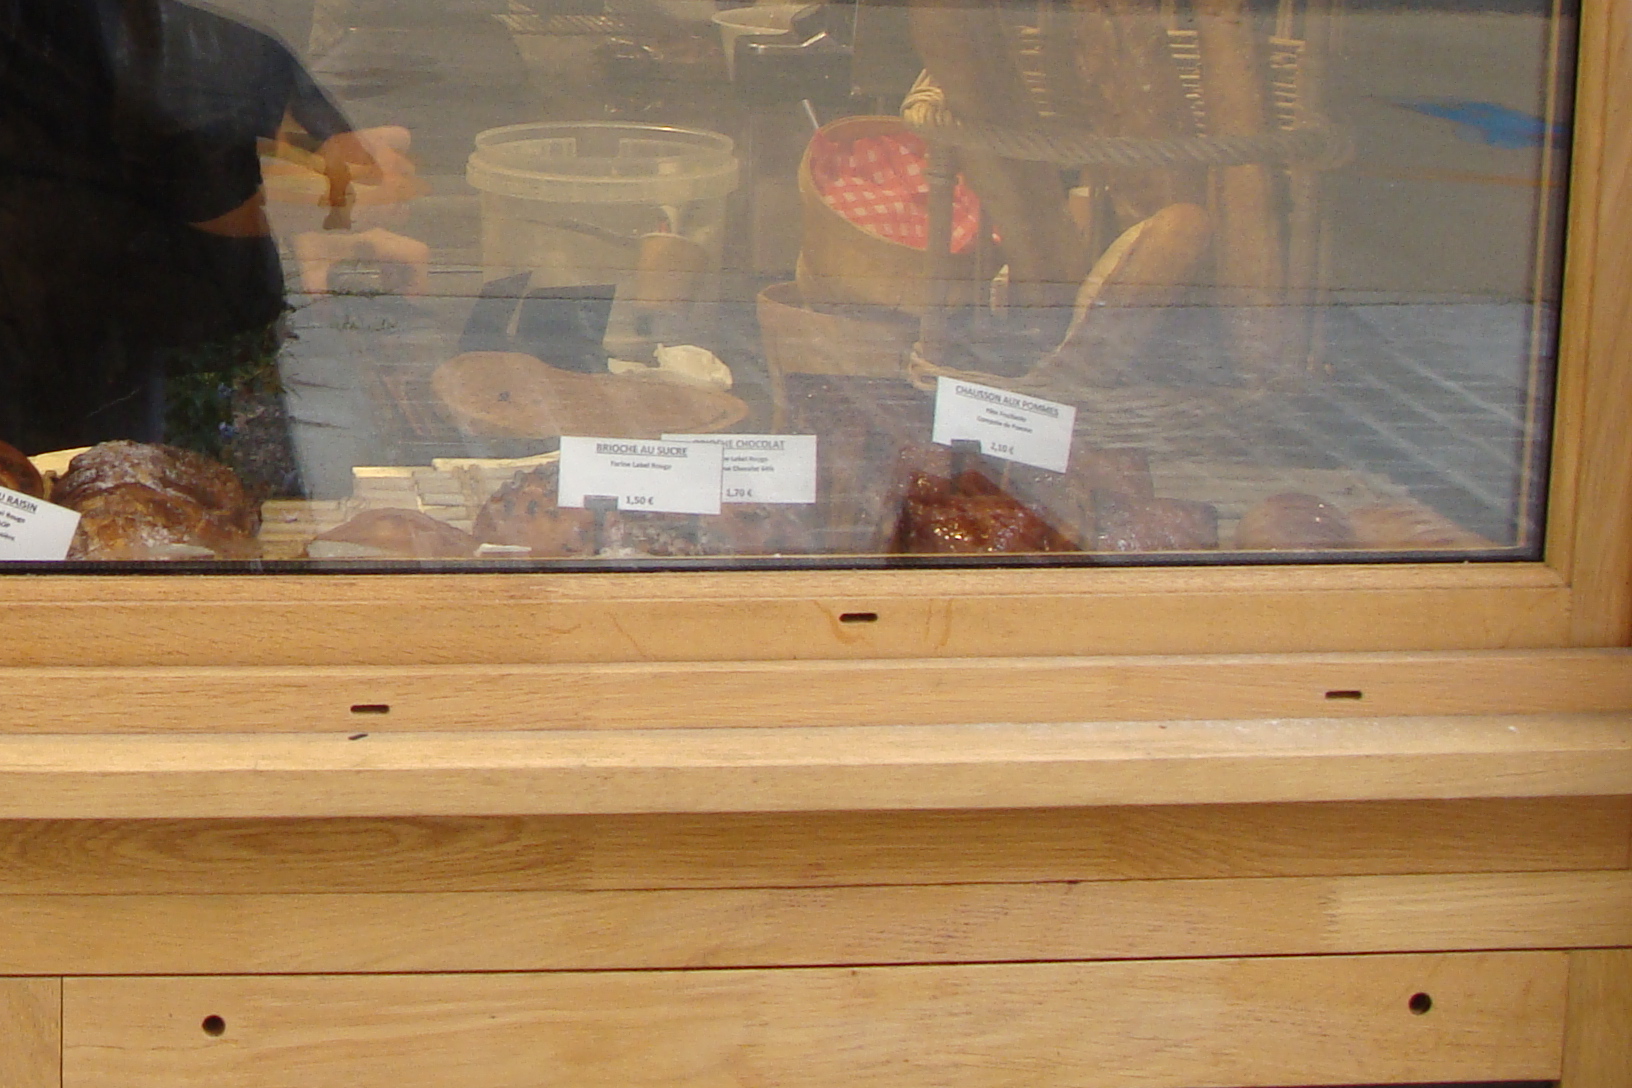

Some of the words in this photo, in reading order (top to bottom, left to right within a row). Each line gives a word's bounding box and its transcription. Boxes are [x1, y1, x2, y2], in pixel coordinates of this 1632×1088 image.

[955, 385, 1001, 403] CHAUSSON
[1003, 396, 1020, 407] AUX
[1022, 400, 1059, 417] POMMES
[596, 443, 638, 454] BRIOCHE
[640, 445, 655, 455] AU
[657, 446, 688, 457] SUCRE
[736, 439, 786, 450] CHOCOLAT
[610, 460, 631, 468] Farine
[632, 461, 650, 469] Label
[651, 463, 672, 471] Rouge
[7, 495, 38, 513] RAISIN
[626, 496, 646, 506] 1,50
[648, 496, 654, 505] €
[6, 511, 26, 524] Rouge
